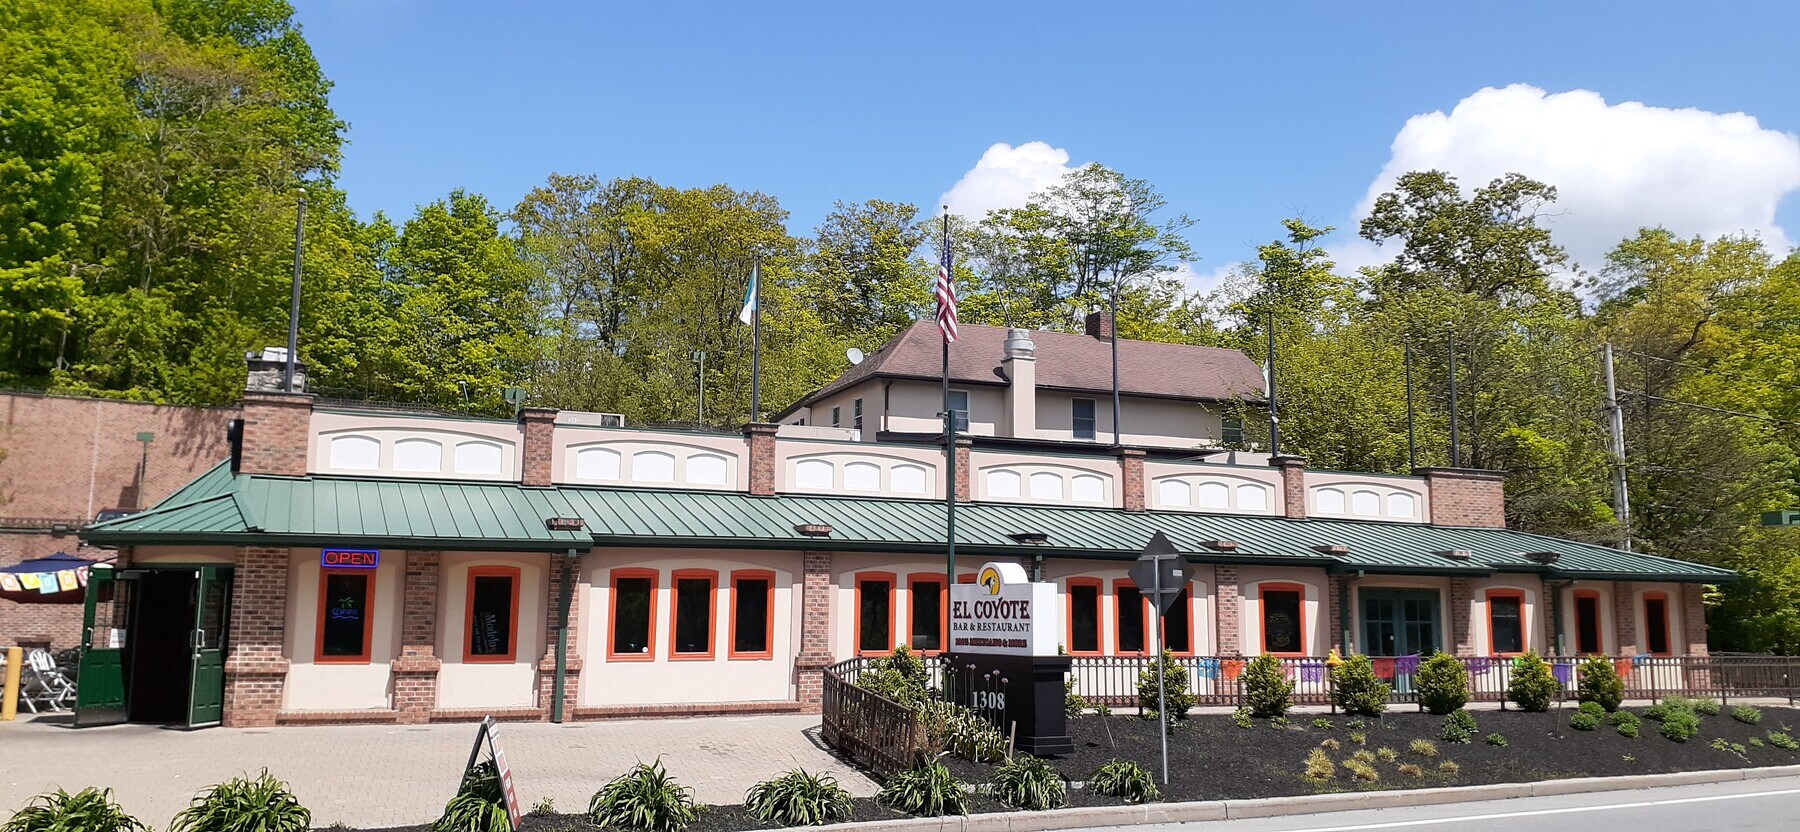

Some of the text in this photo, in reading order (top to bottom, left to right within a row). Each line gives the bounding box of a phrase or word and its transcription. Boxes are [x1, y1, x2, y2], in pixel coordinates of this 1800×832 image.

[325, 551, 375, 565] OPEN
[953, 597, 1030, 619] EL COYOTE
[484, 613, 499, 648] Modelo
[953, 622, 1030, 632] BAR & RESTAURANT
[972, 691, 1005, 710] 1308
